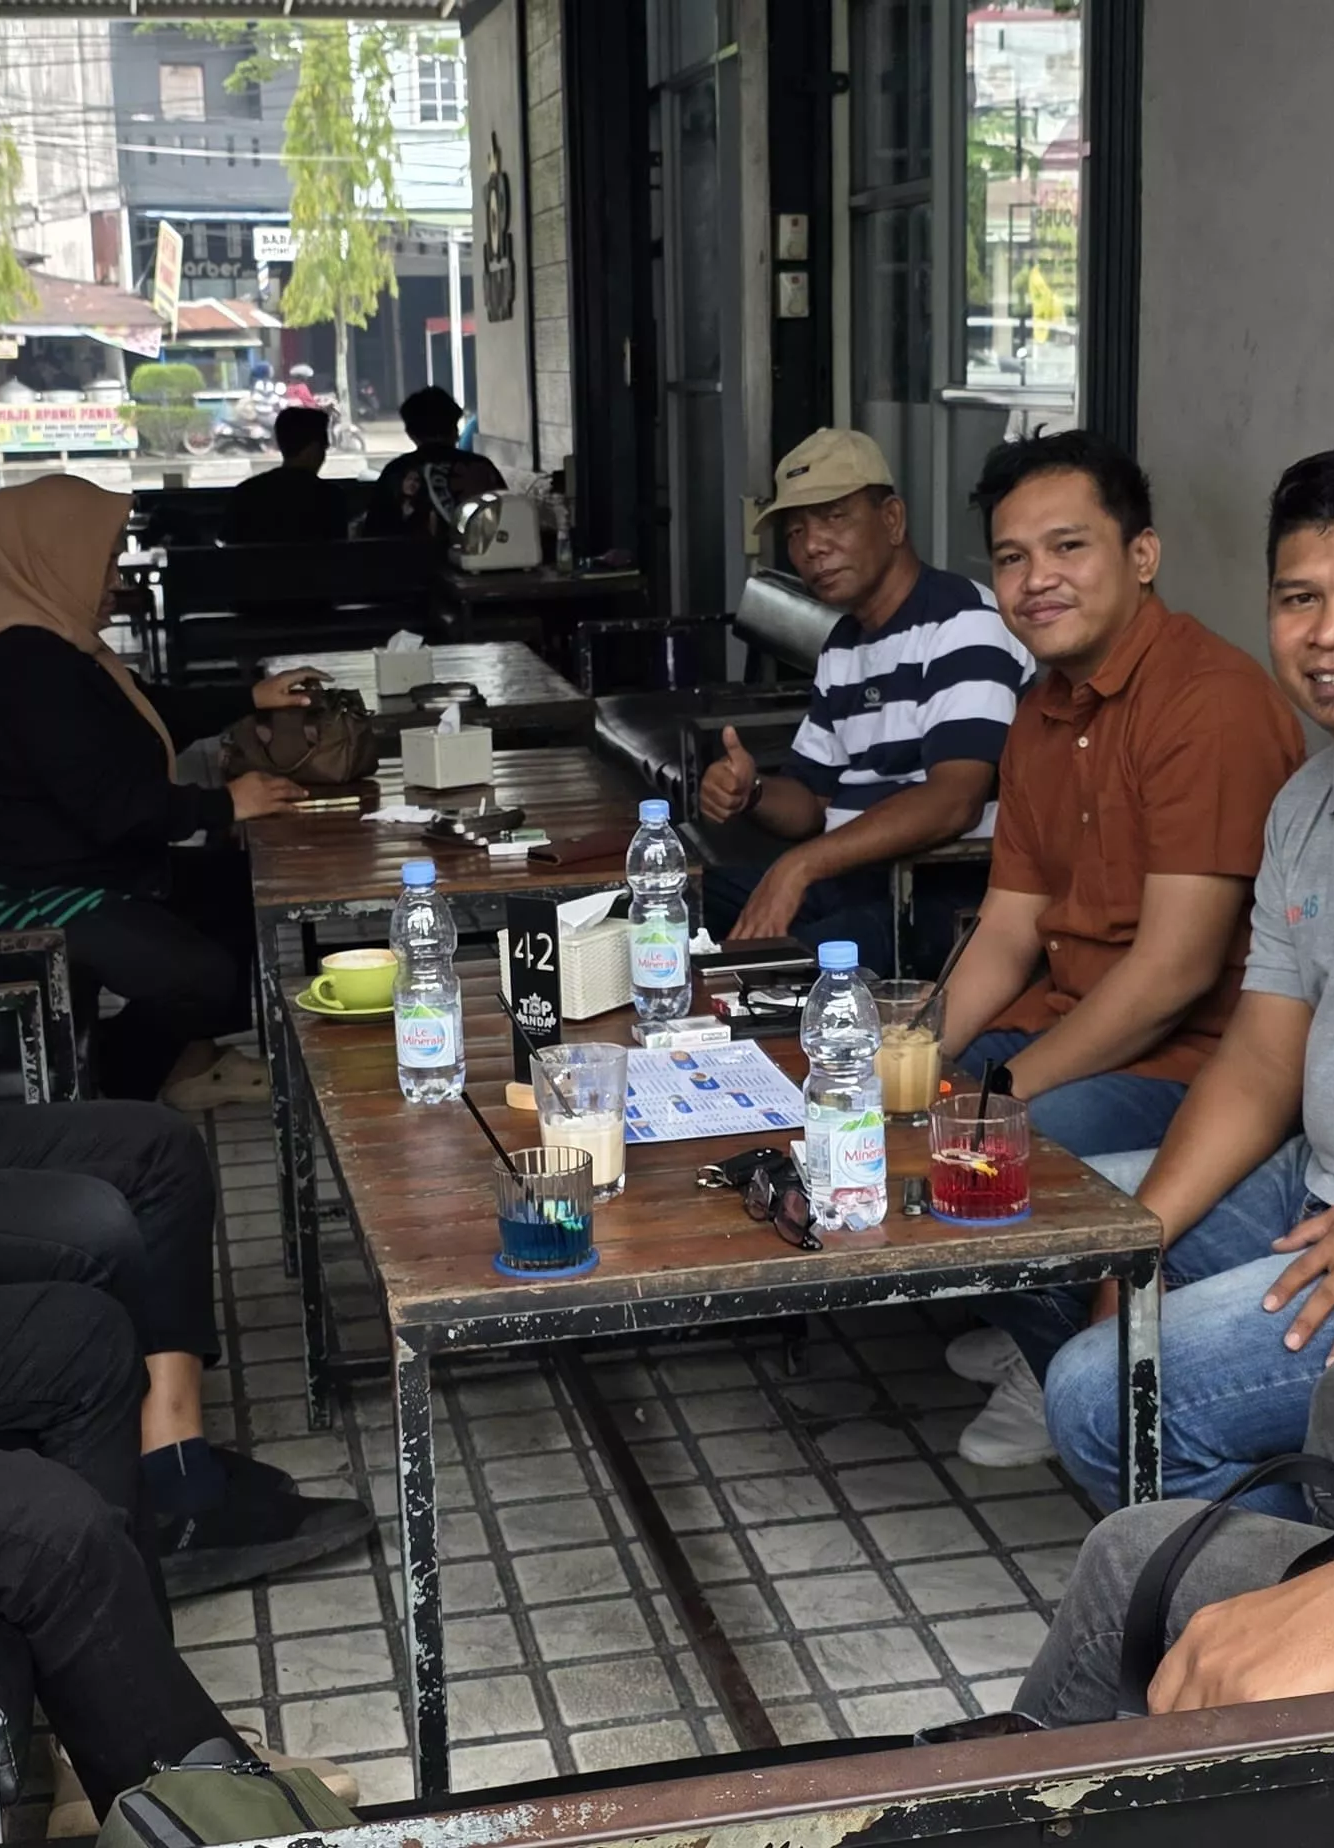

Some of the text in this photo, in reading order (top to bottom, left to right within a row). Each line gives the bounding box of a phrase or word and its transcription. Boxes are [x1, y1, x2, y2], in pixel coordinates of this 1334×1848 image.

[1301, 894, 1319, 919] 46
[513, 931, 555, 972] 42
[519, 996, 553, 1017] TOP
[863, 1137, 876, 1150] Le
